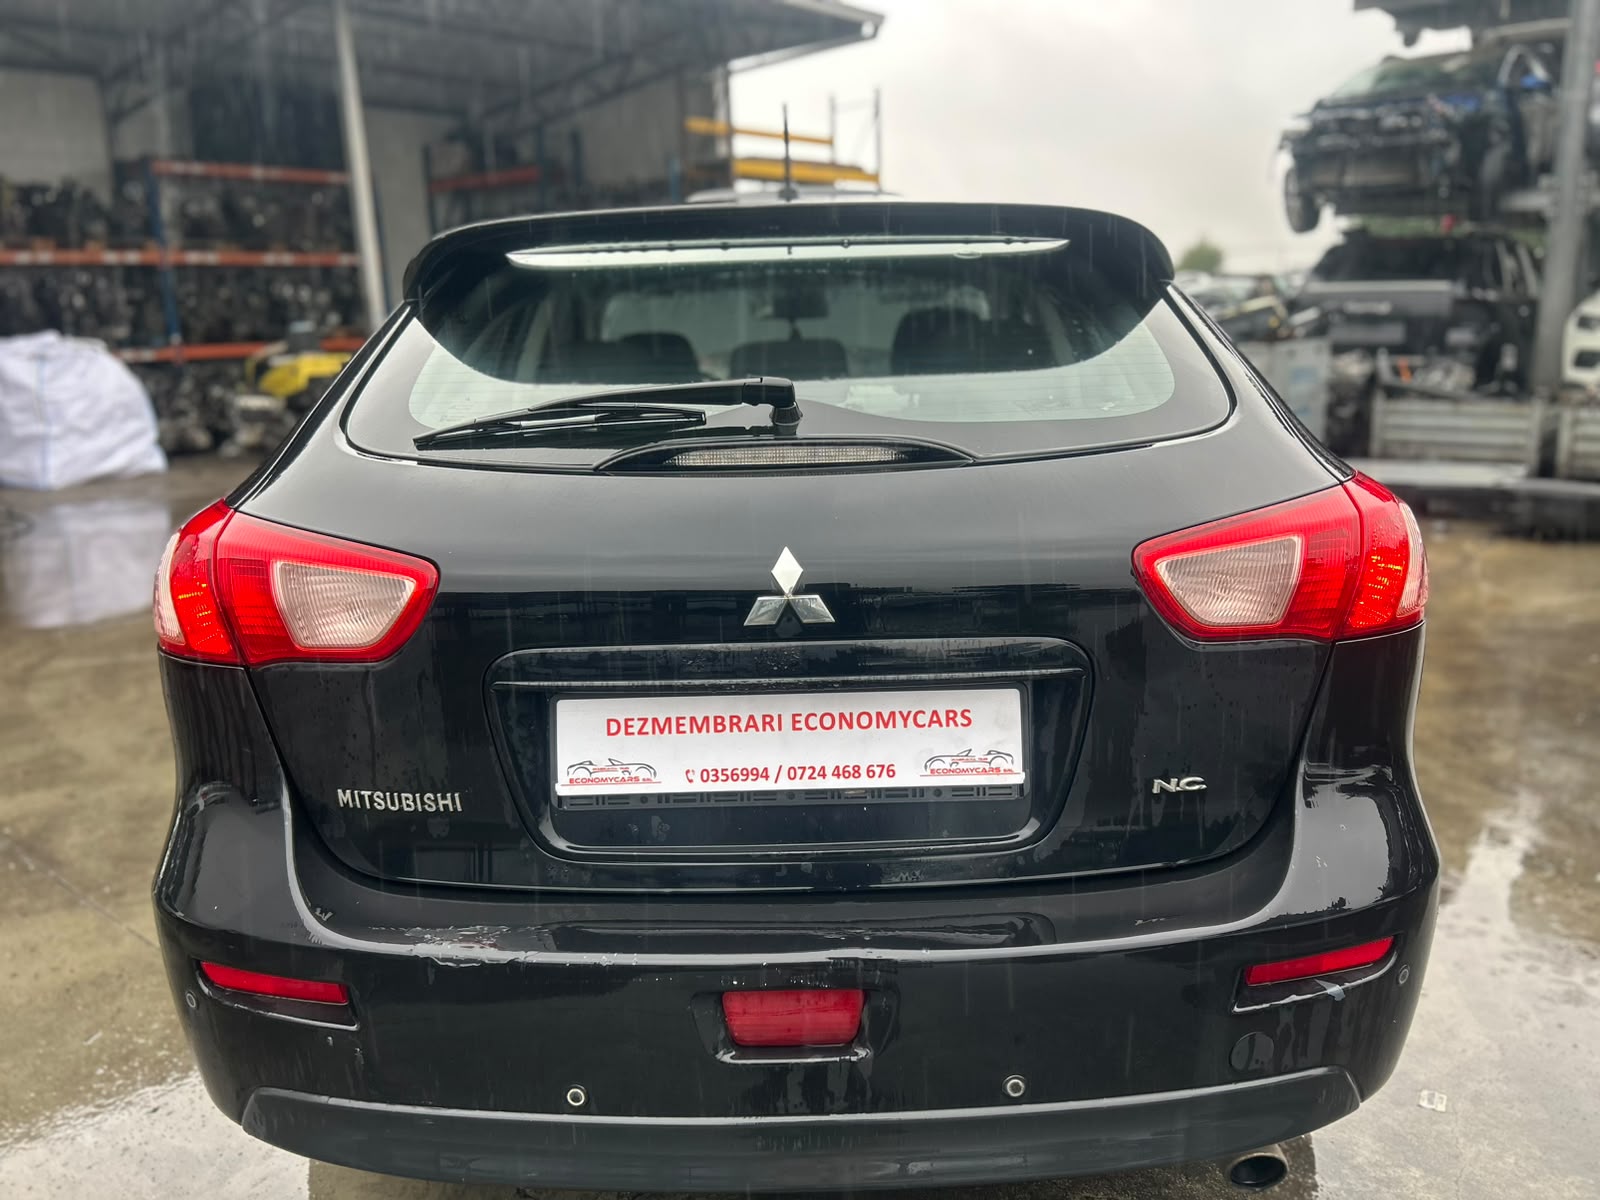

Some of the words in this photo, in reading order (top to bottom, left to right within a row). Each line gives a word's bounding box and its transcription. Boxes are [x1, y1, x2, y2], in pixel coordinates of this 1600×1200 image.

[605, 713, 784, 737] DEZMEMBRARI
[791, 708, 973, 732] ECONOMYCARS
[569, 776, 640, 784] ECONOMYCARS
[699, 766, 770, 783] 0356994
[774, 764, 783, 784] /
[787, 765, 828, 781] 0724
[831, 764, 862, 780] 468
[866, 763, 896, 779] 676
[930, 767, 1001, 775] ECONOMYCARS
[337, 788, 462, 812] MITSUBISHI
